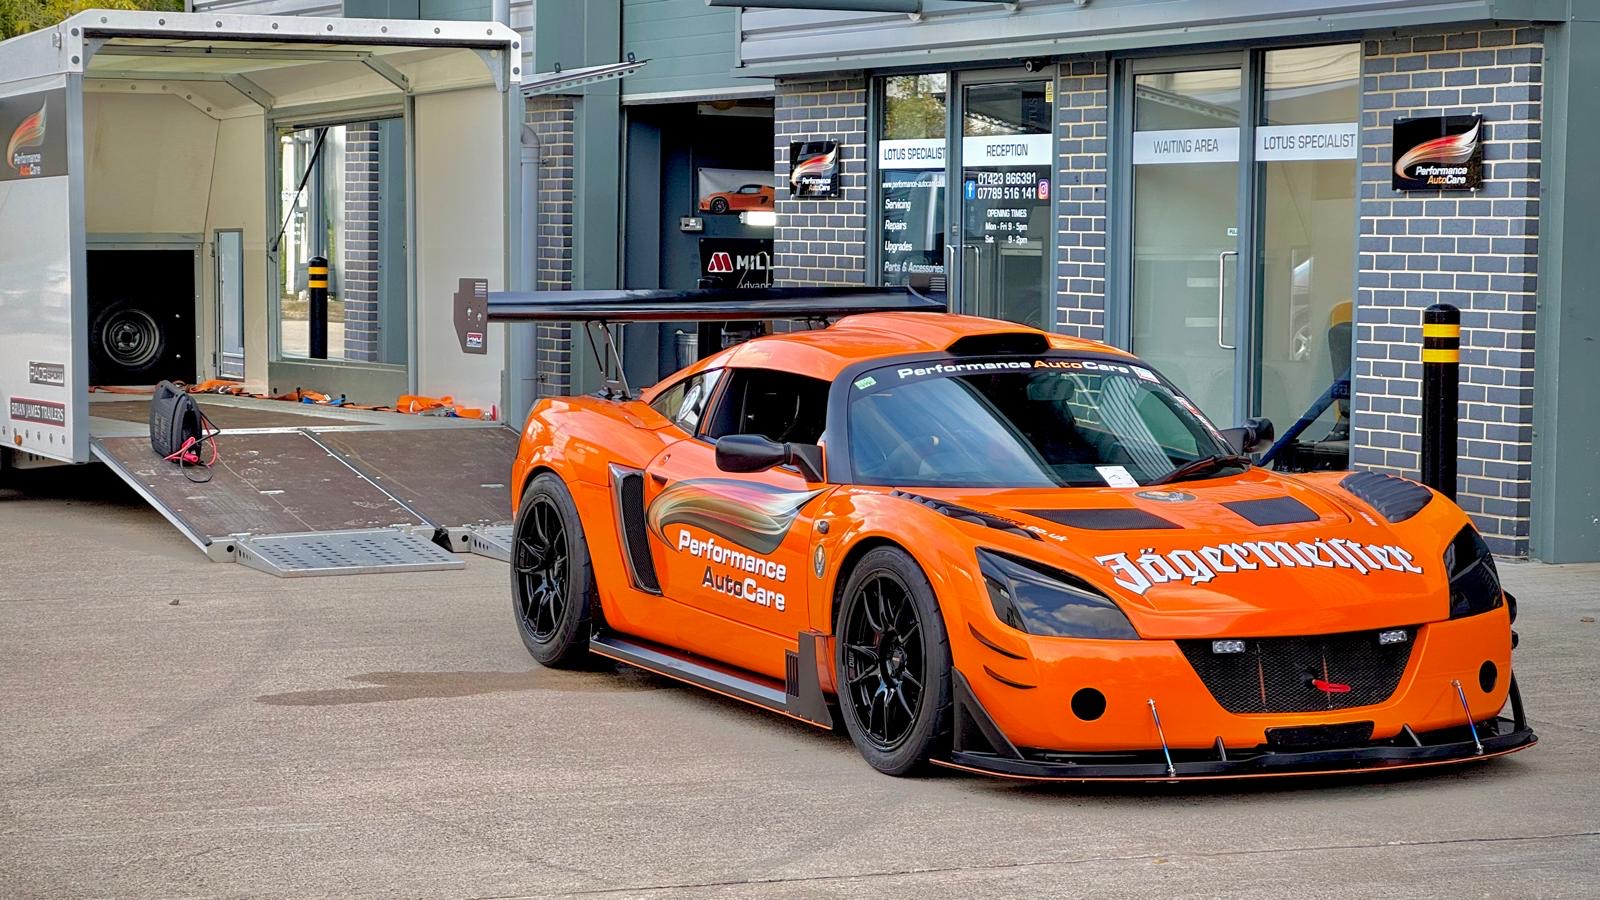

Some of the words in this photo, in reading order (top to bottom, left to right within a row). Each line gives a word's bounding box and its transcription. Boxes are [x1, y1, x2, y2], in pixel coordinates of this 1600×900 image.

[1153, 139, 1192, 154] WAITING
[1194, 138, 1219, 152] AREA
[1264, 135, 1295, 150] LOTUS
[1298, 133, 1356, 149] SPECIALIST
[884, 148, 906, 160] LOTUS
[907, 146, 946, 160] SPECIALIST
[986, 143, 1029, 157] RECEPTION
[1415, 165, 1468, 176] Performance
[801, 176, 832, 185] Performance
[977, 172, 1004, 185] 01423
[1005, 171, 1036, 185] 866391
[1426, 174, 1467, 185] AutoCare
[808, 183, 831, 192] AutoCare
[977, 187, 1003, 200] 07789
[1004, 187, 1020, 200] 516
[1021, 186, 1037, 200] 141
[884, 198, 912, 212] Servicing
[986, 208, 1011, 218] OPENING
[1011, 208, 1028, 218] TIMES
[884, 219, 908, 233] Repairs
[985, 222, 997, 231] Mon
[1000, 222, 1008, 231] Fri
[1008, 222, 1013, 231] 9
[1016, 222, 1028, 233] 5pm
[884, 240, 913, 254] Upgrades
[984, 234, 995, 244] Sat
[1007, 235, 1013, 244] 9
[1016, 235, 1028, 247] 2pm
[884, 261, 901, 272] Parts
[902, 261, 908, 272] &
[908, 261, 944, 273] Accessories
[897, 360, 1032, 379] Performance
[1032, 359, 1130, 374] AutoCare
[11, 402, 26, 416] BRIAN
[25, 403, 41, 418] JAMES
[41, 405, 64, 422] TRAILERS
[677, 528, 787, 583] Performance
[702, 565, 786, 612] AutoCare
